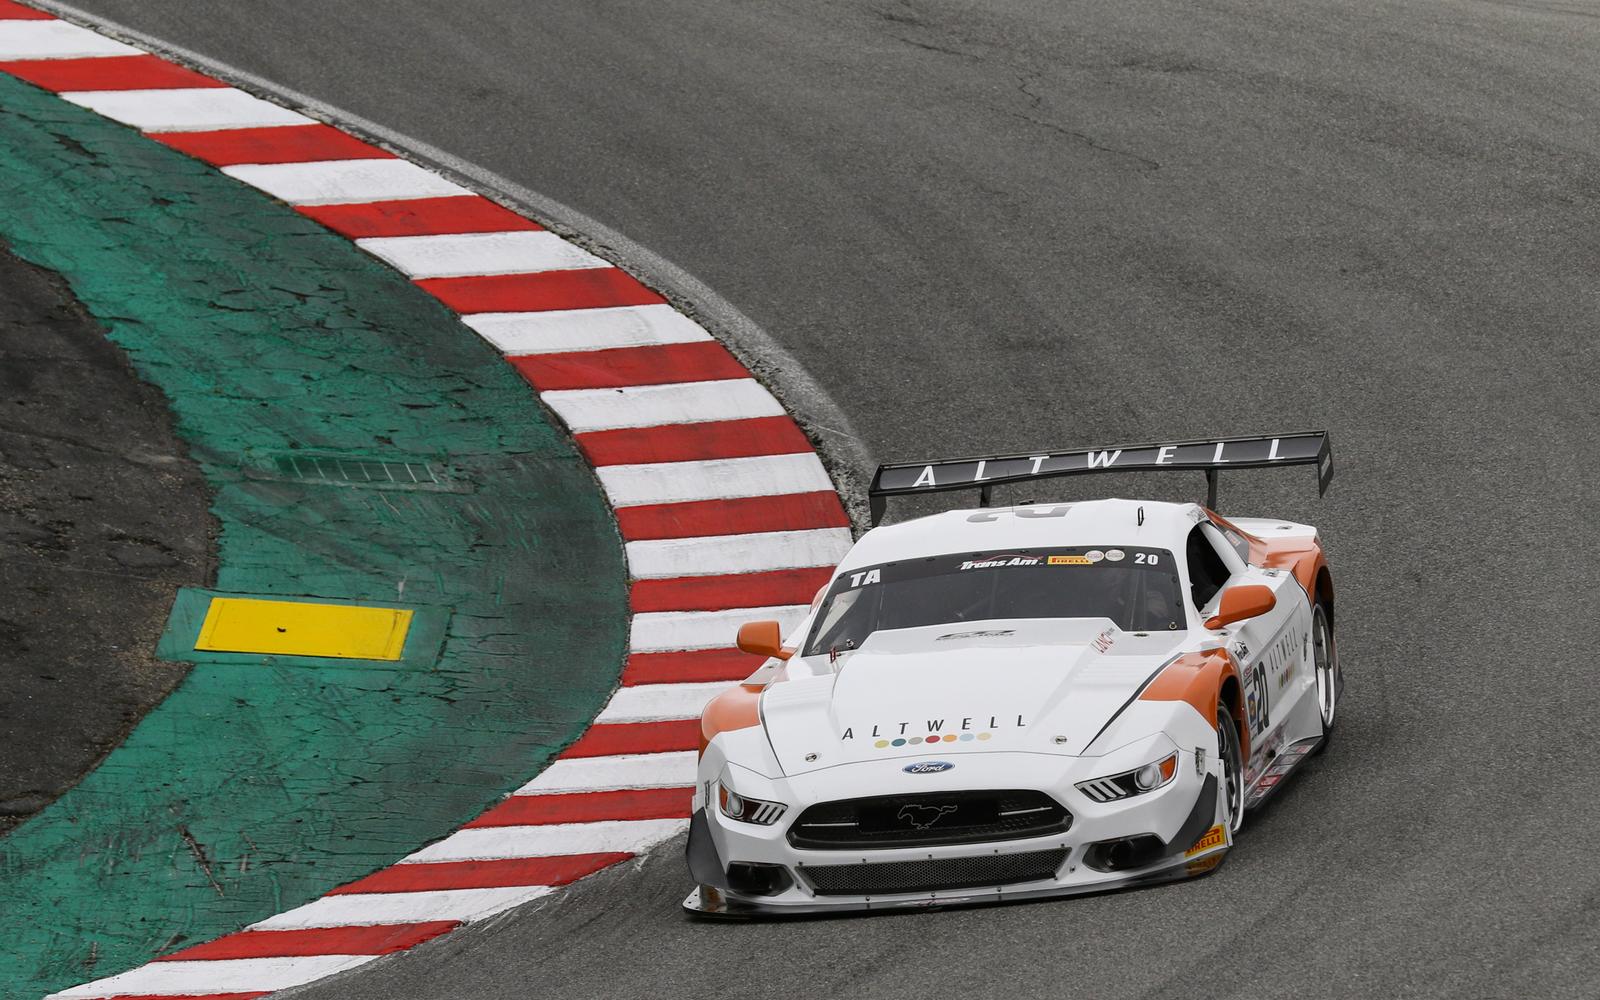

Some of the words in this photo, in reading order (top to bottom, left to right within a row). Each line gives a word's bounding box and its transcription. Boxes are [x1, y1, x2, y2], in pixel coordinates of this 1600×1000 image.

[912, 438, 1285, 487] ALTWELL
[960, 559, 1006, 571] Trans
[1006, 556, 1038, 567] Am
[1134, 552, 1159, 566] 20
[849, 568, 881, 588] TA
[1253, 661, 1270, 735] 20
[842, 714, 1027, 740] ALTWELL
[911, 762, 945, 774] Ford
